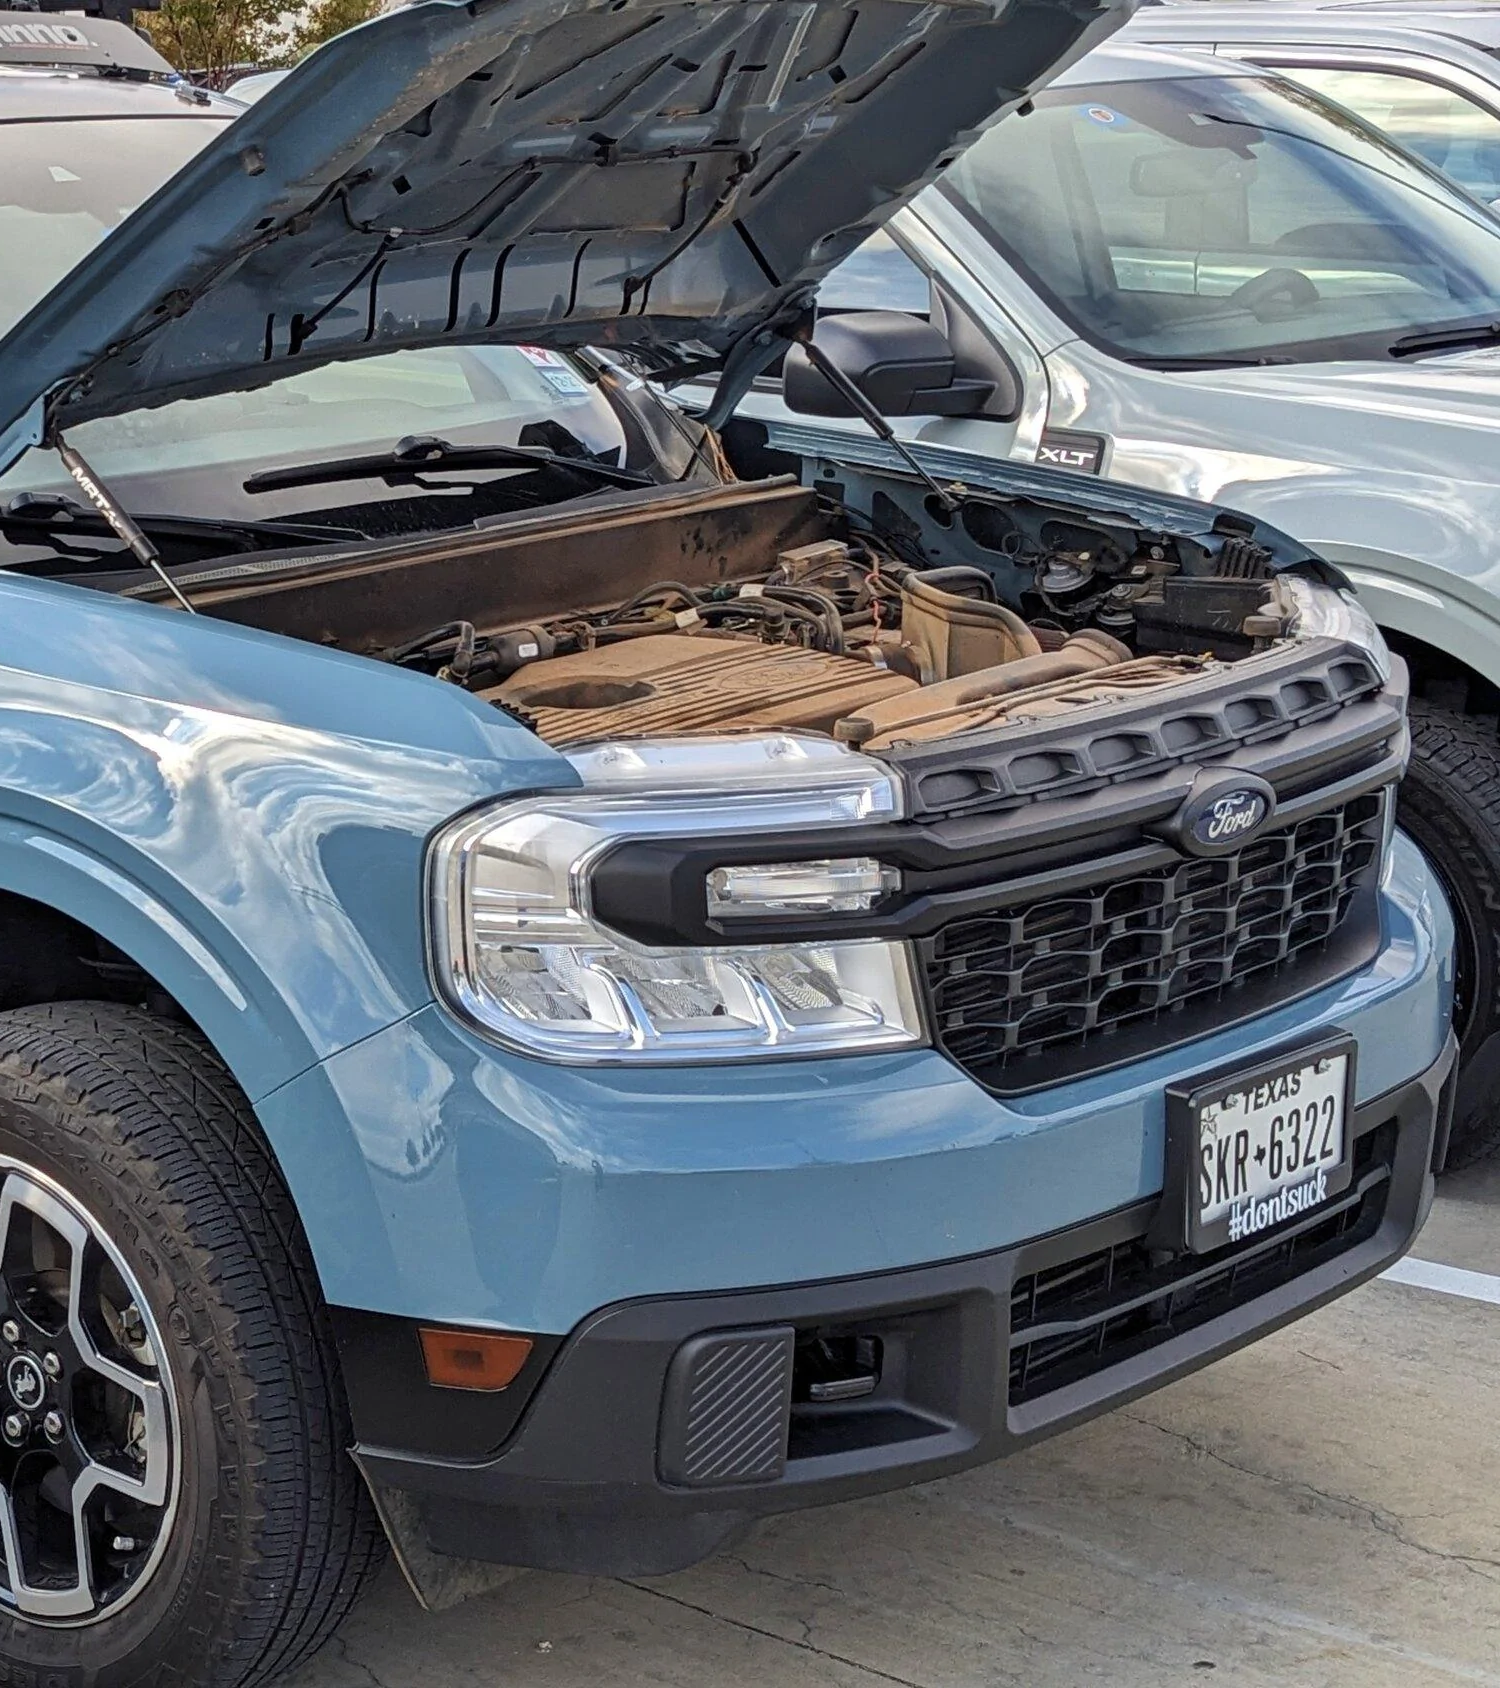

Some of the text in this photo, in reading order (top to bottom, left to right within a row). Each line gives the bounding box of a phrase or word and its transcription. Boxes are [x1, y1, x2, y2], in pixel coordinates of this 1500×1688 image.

[1039, 447, 1094, 465] XLT
[1208, 795, 1256, 839] Ford
[1243, 1073, 1301, 1115] TEXAS
[1228, 1167, 1328, 1242] #dontsuck
